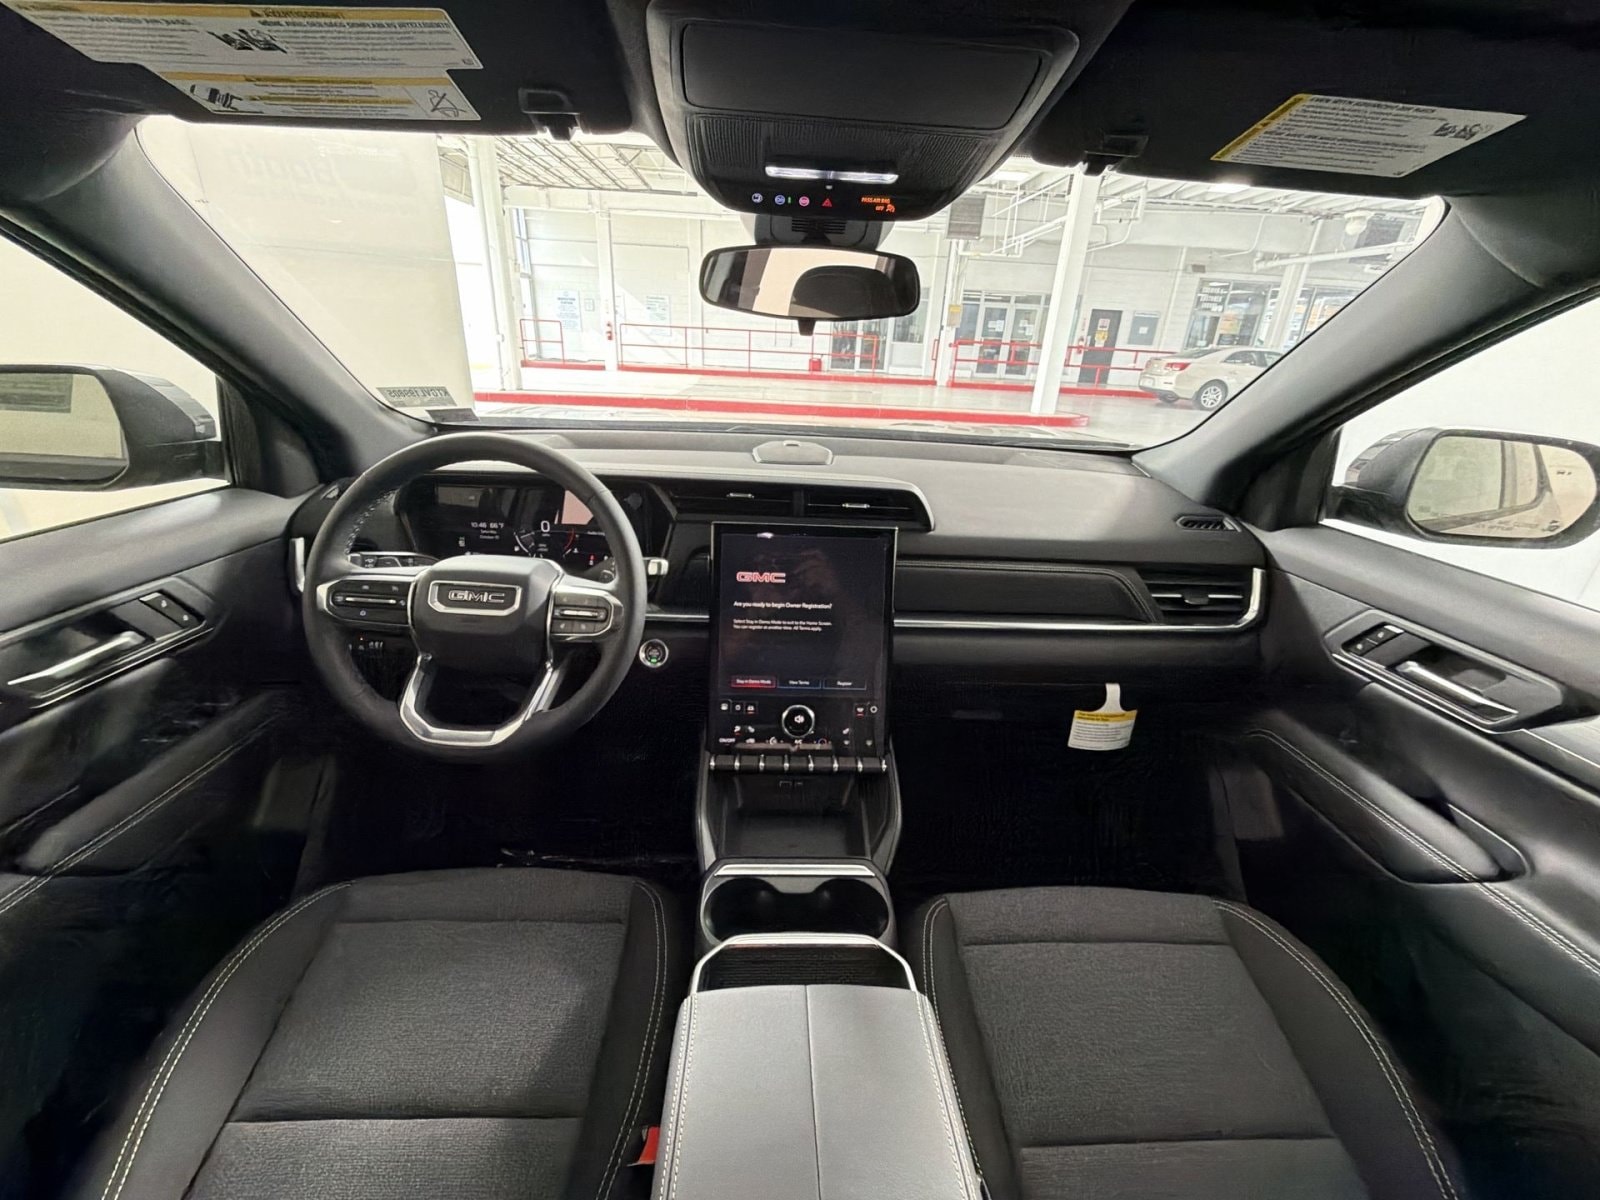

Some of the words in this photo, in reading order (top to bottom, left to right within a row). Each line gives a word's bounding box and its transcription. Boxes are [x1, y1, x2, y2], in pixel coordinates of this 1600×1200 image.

[541, 520, 550, 533] 0
[736, 571, 787, 584] GMC
[448, 590, 506, 604] GMC
